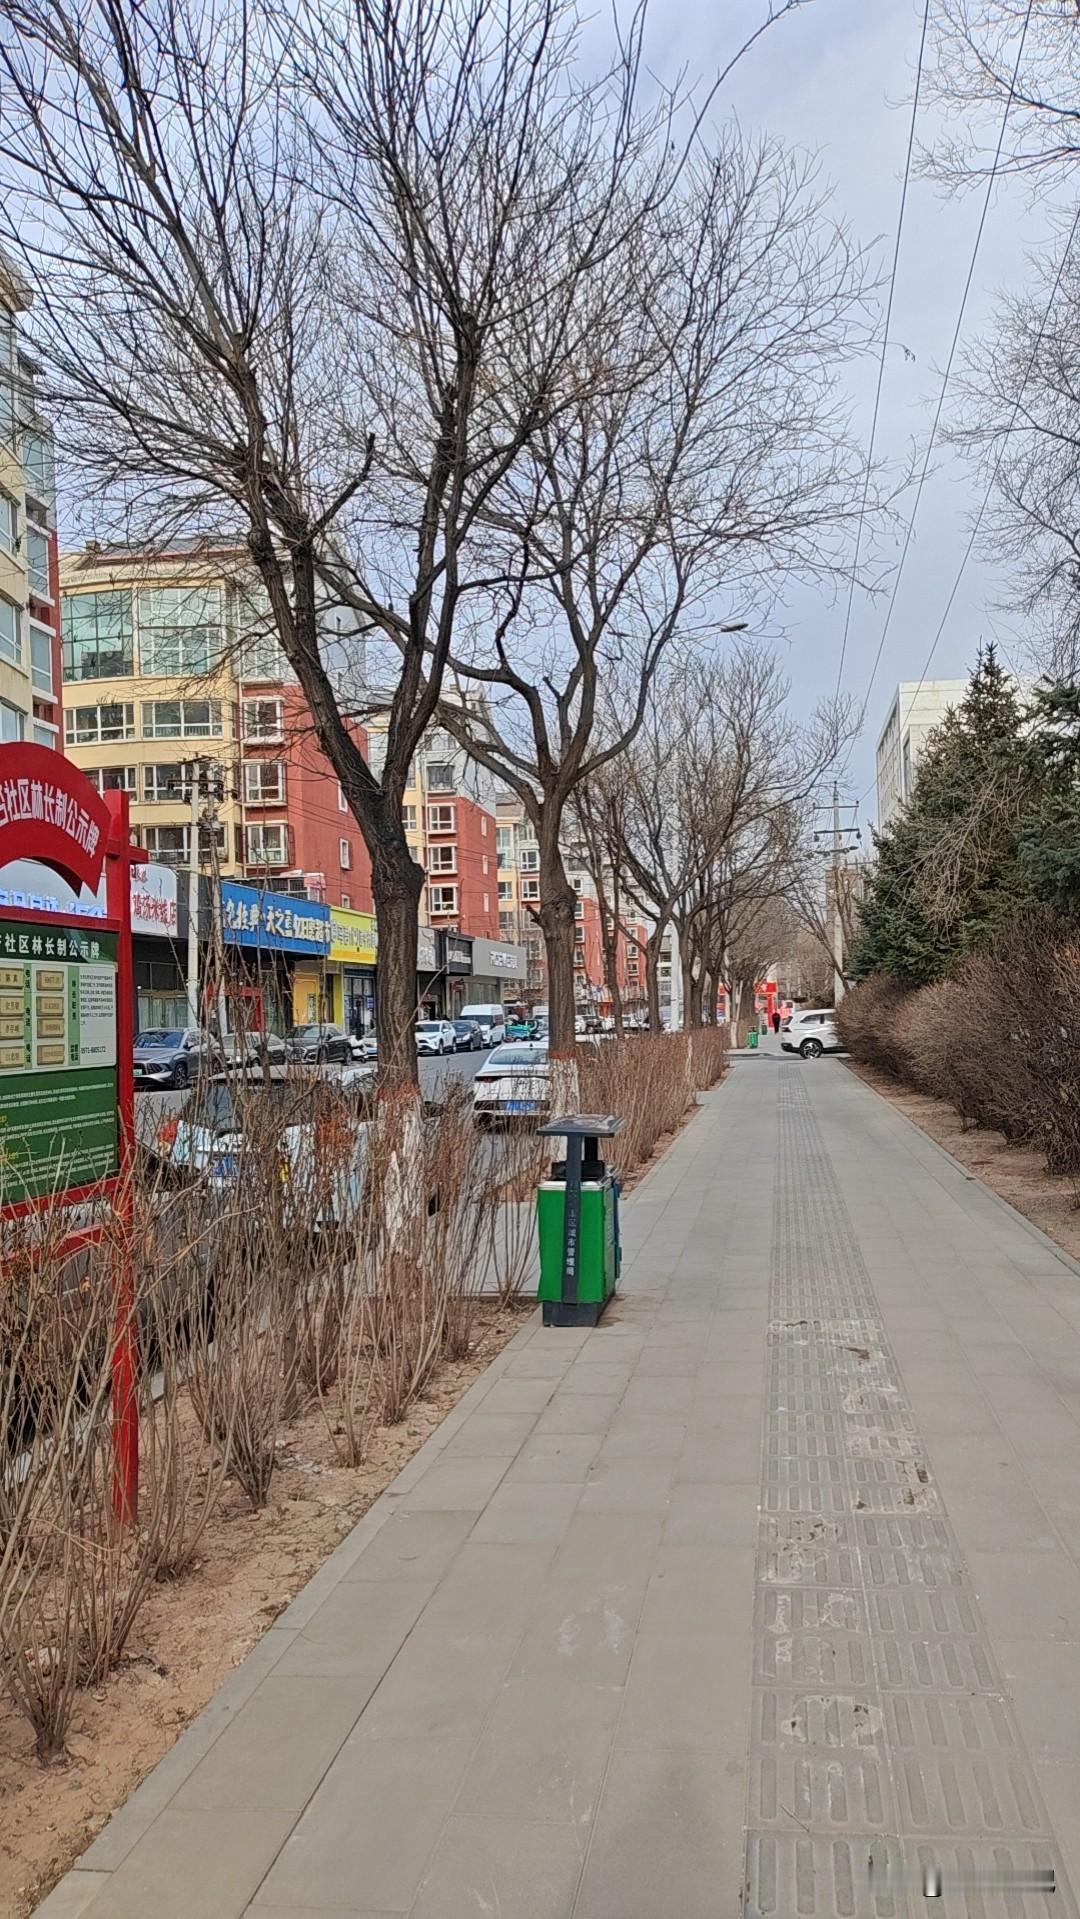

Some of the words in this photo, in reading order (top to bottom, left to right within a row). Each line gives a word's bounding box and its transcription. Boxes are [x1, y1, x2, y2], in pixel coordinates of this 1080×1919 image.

[0, 933, 100, 959] 社区林长制公示牌
